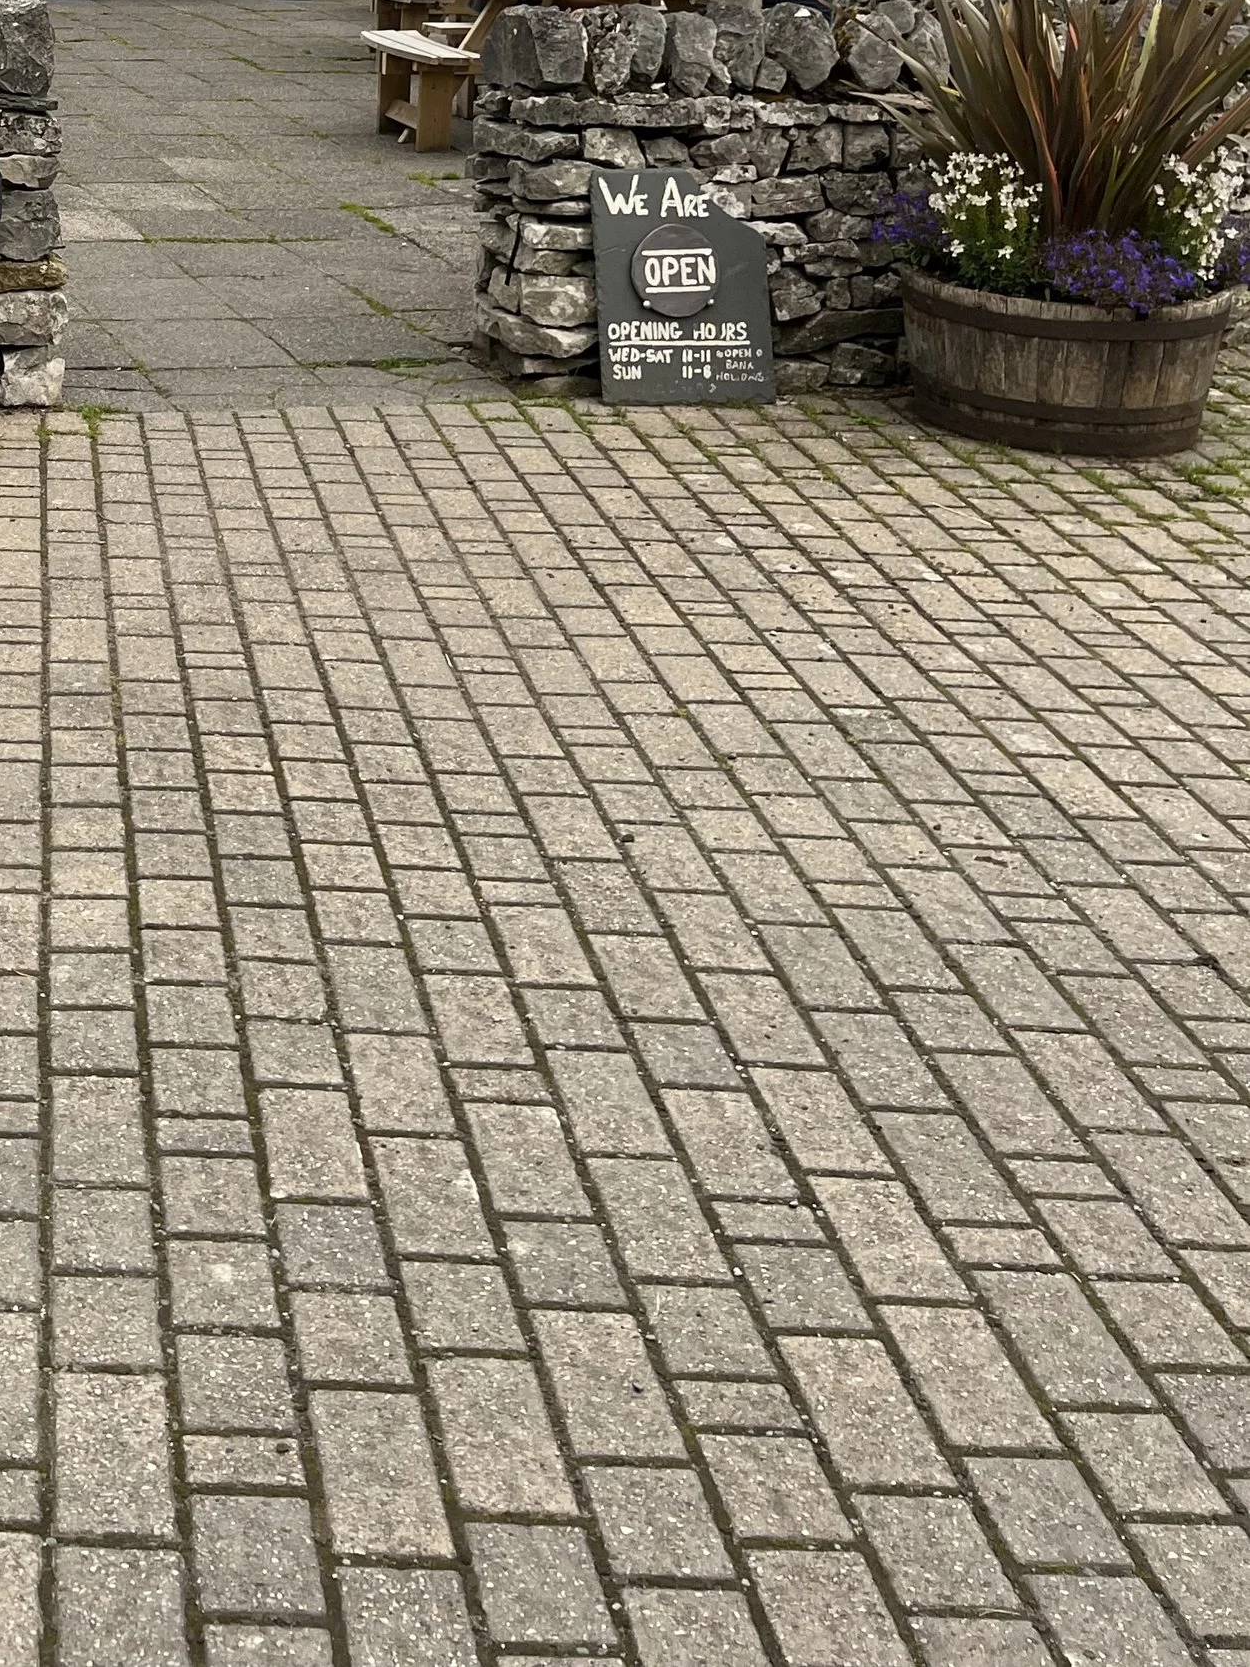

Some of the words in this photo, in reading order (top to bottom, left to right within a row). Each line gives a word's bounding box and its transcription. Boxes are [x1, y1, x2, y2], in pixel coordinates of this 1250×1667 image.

[644, 254, 716, 287] OPEN
[607, 321, 683, 341] OPENING
[681, 348, 712, 363] 11-11
[724, 348, 752, 358] OPEN
[612, 363, 642, 380] SUN
